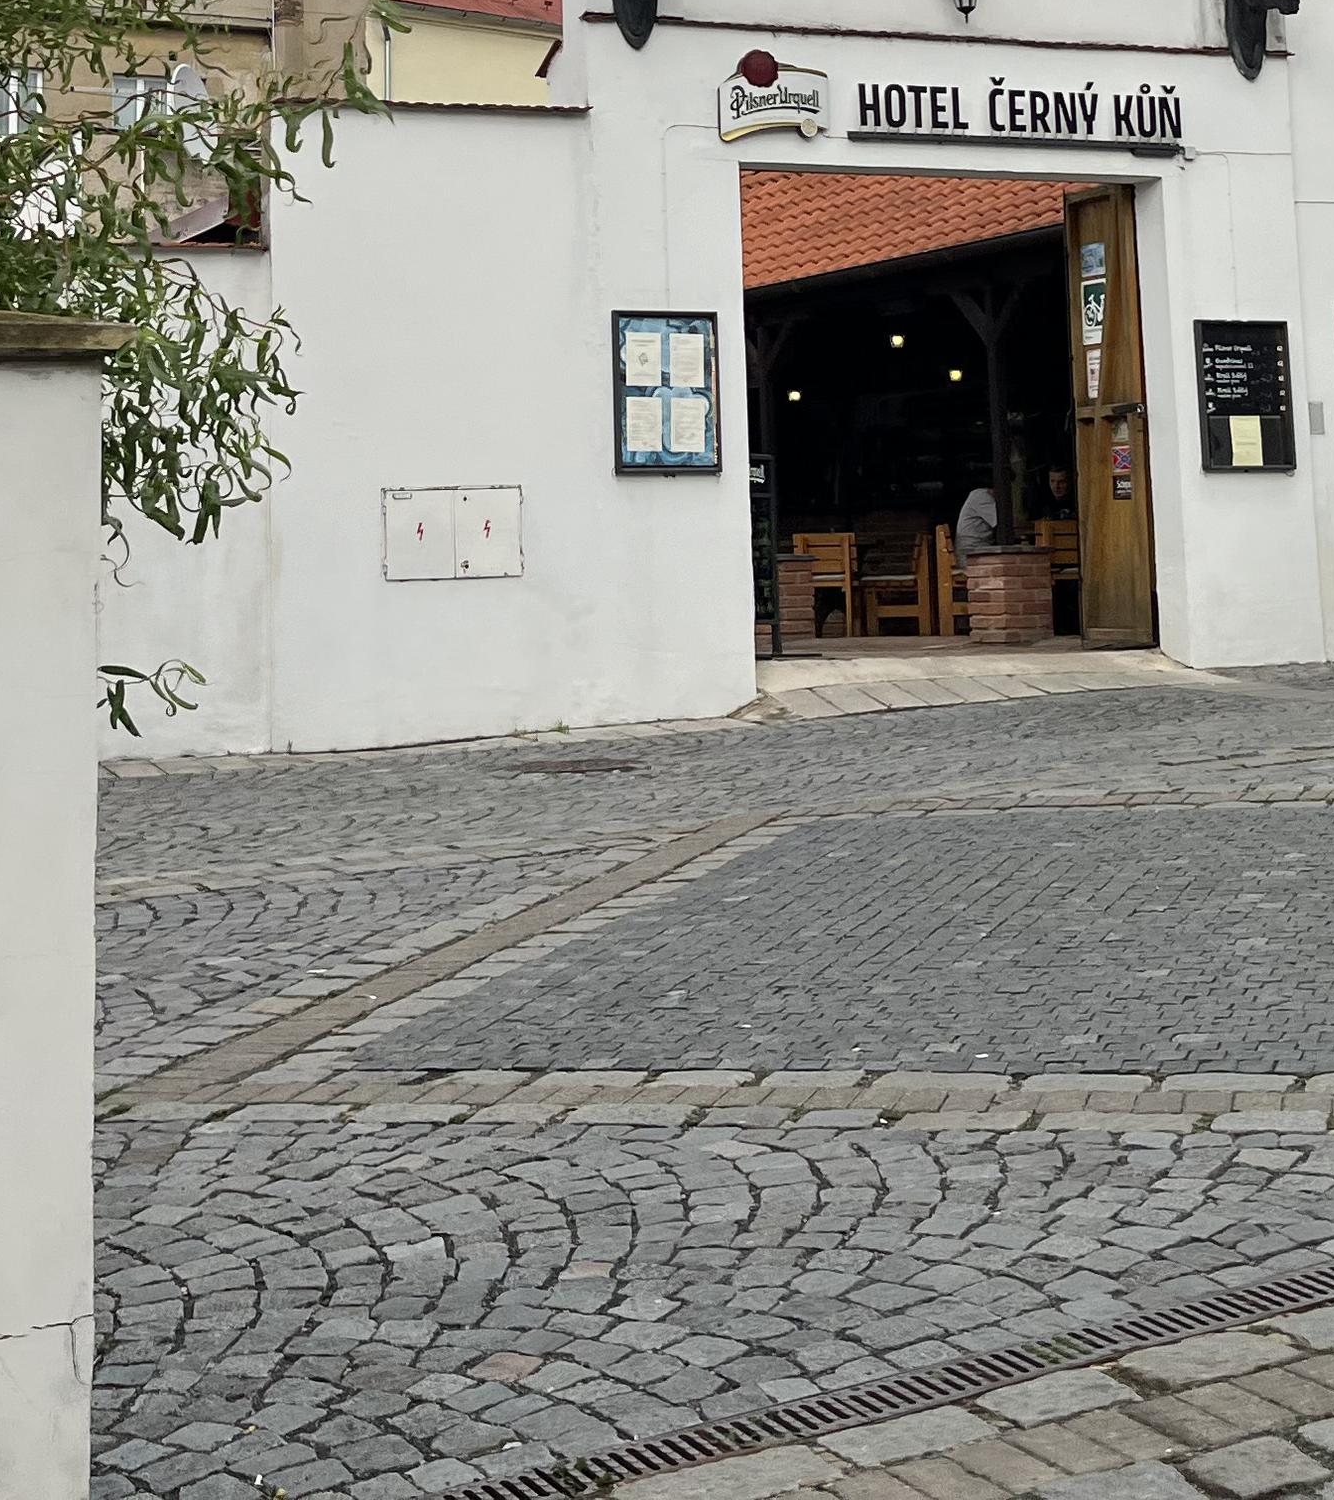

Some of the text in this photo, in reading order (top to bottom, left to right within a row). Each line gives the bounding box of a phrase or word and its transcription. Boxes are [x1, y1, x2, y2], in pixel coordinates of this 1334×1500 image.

[730, 84, 820, 119] Pilsner Urquell
[858, 76, 1182, 139] HOTEL ČERNÝ KŮŇ
